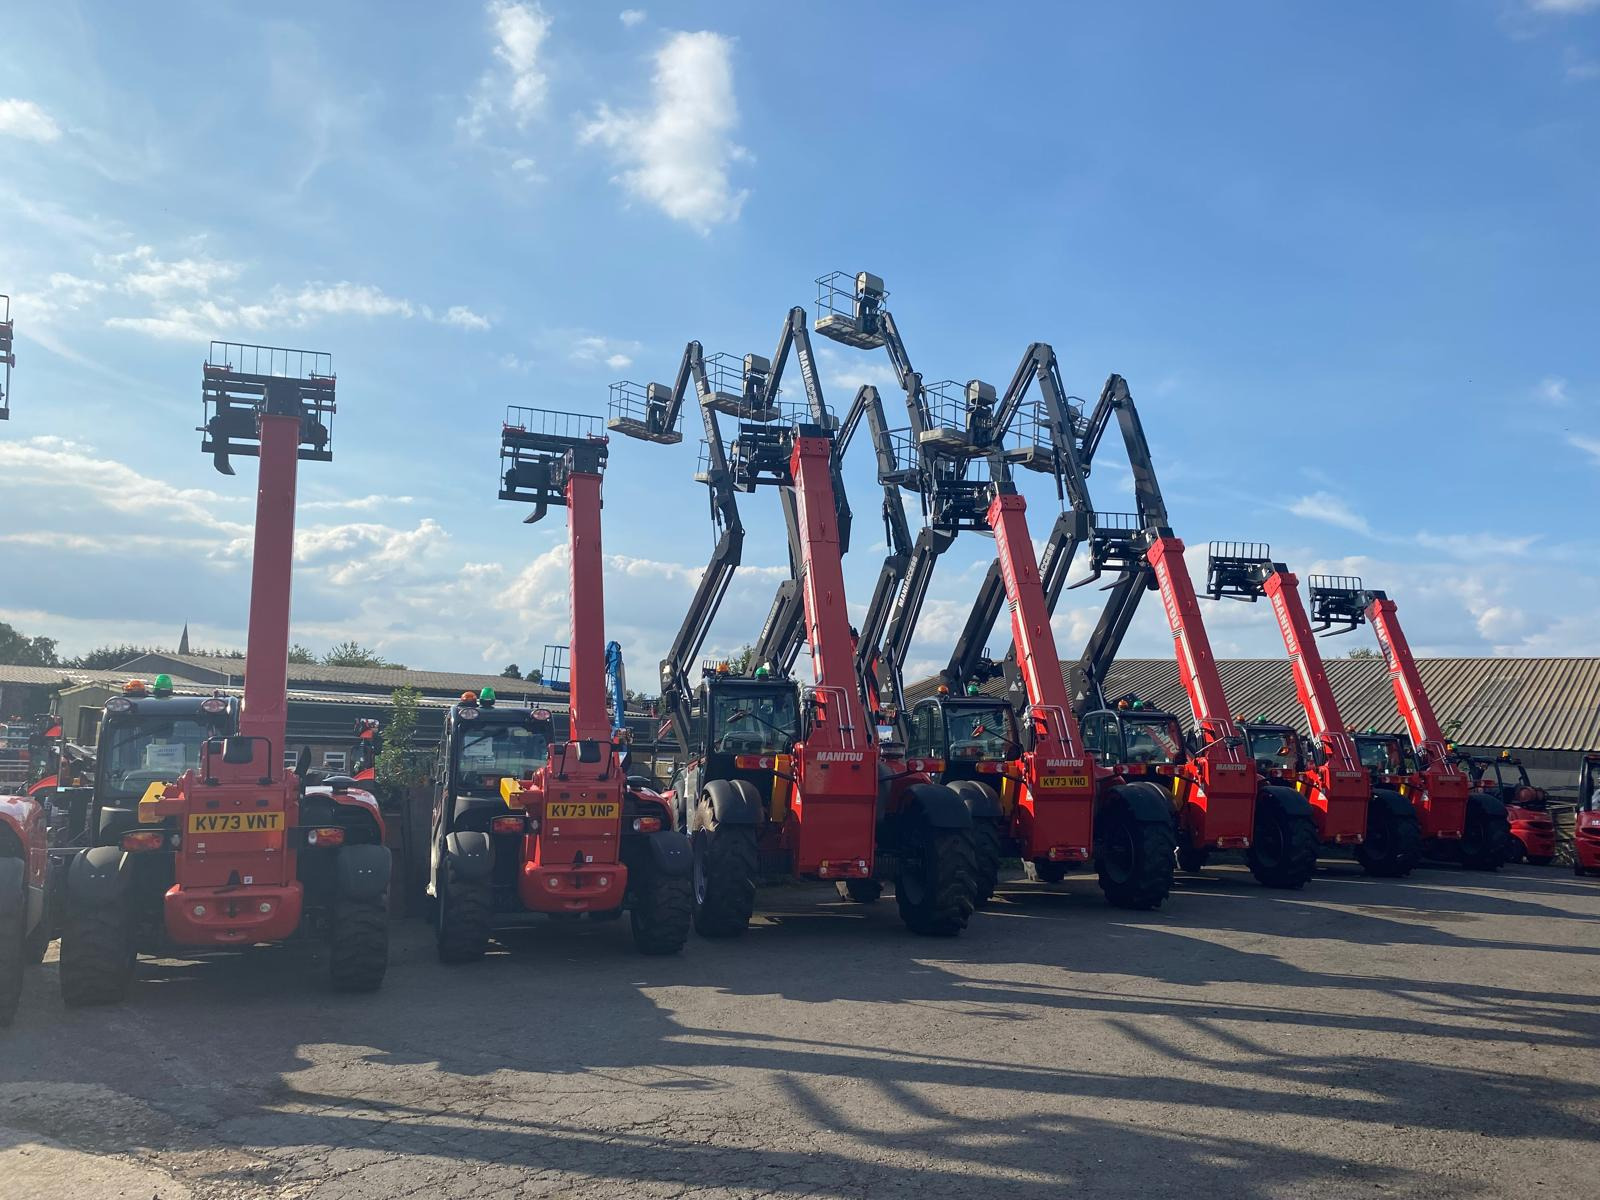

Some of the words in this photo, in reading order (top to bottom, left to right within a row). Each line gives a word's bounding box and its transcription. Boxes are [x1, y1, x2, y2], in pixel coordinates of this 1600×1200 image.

[898, 556, 918, 607] MANIACCESS
[1156, 561, 1181, 629] MANITOU
[1273, 593, 1297, 653] MANITOU
[816, 751, 864, 762] MANITOU
[1046, 759, 1084, 767] MANITOU
[1043, 777, 1067, 787] KV73
[551, 805, 586, 818] KV73
[590, 804, 615, 817] VNP
[194, 814, 241, 832] KV73
[246, 813, 279, 831] VNT
